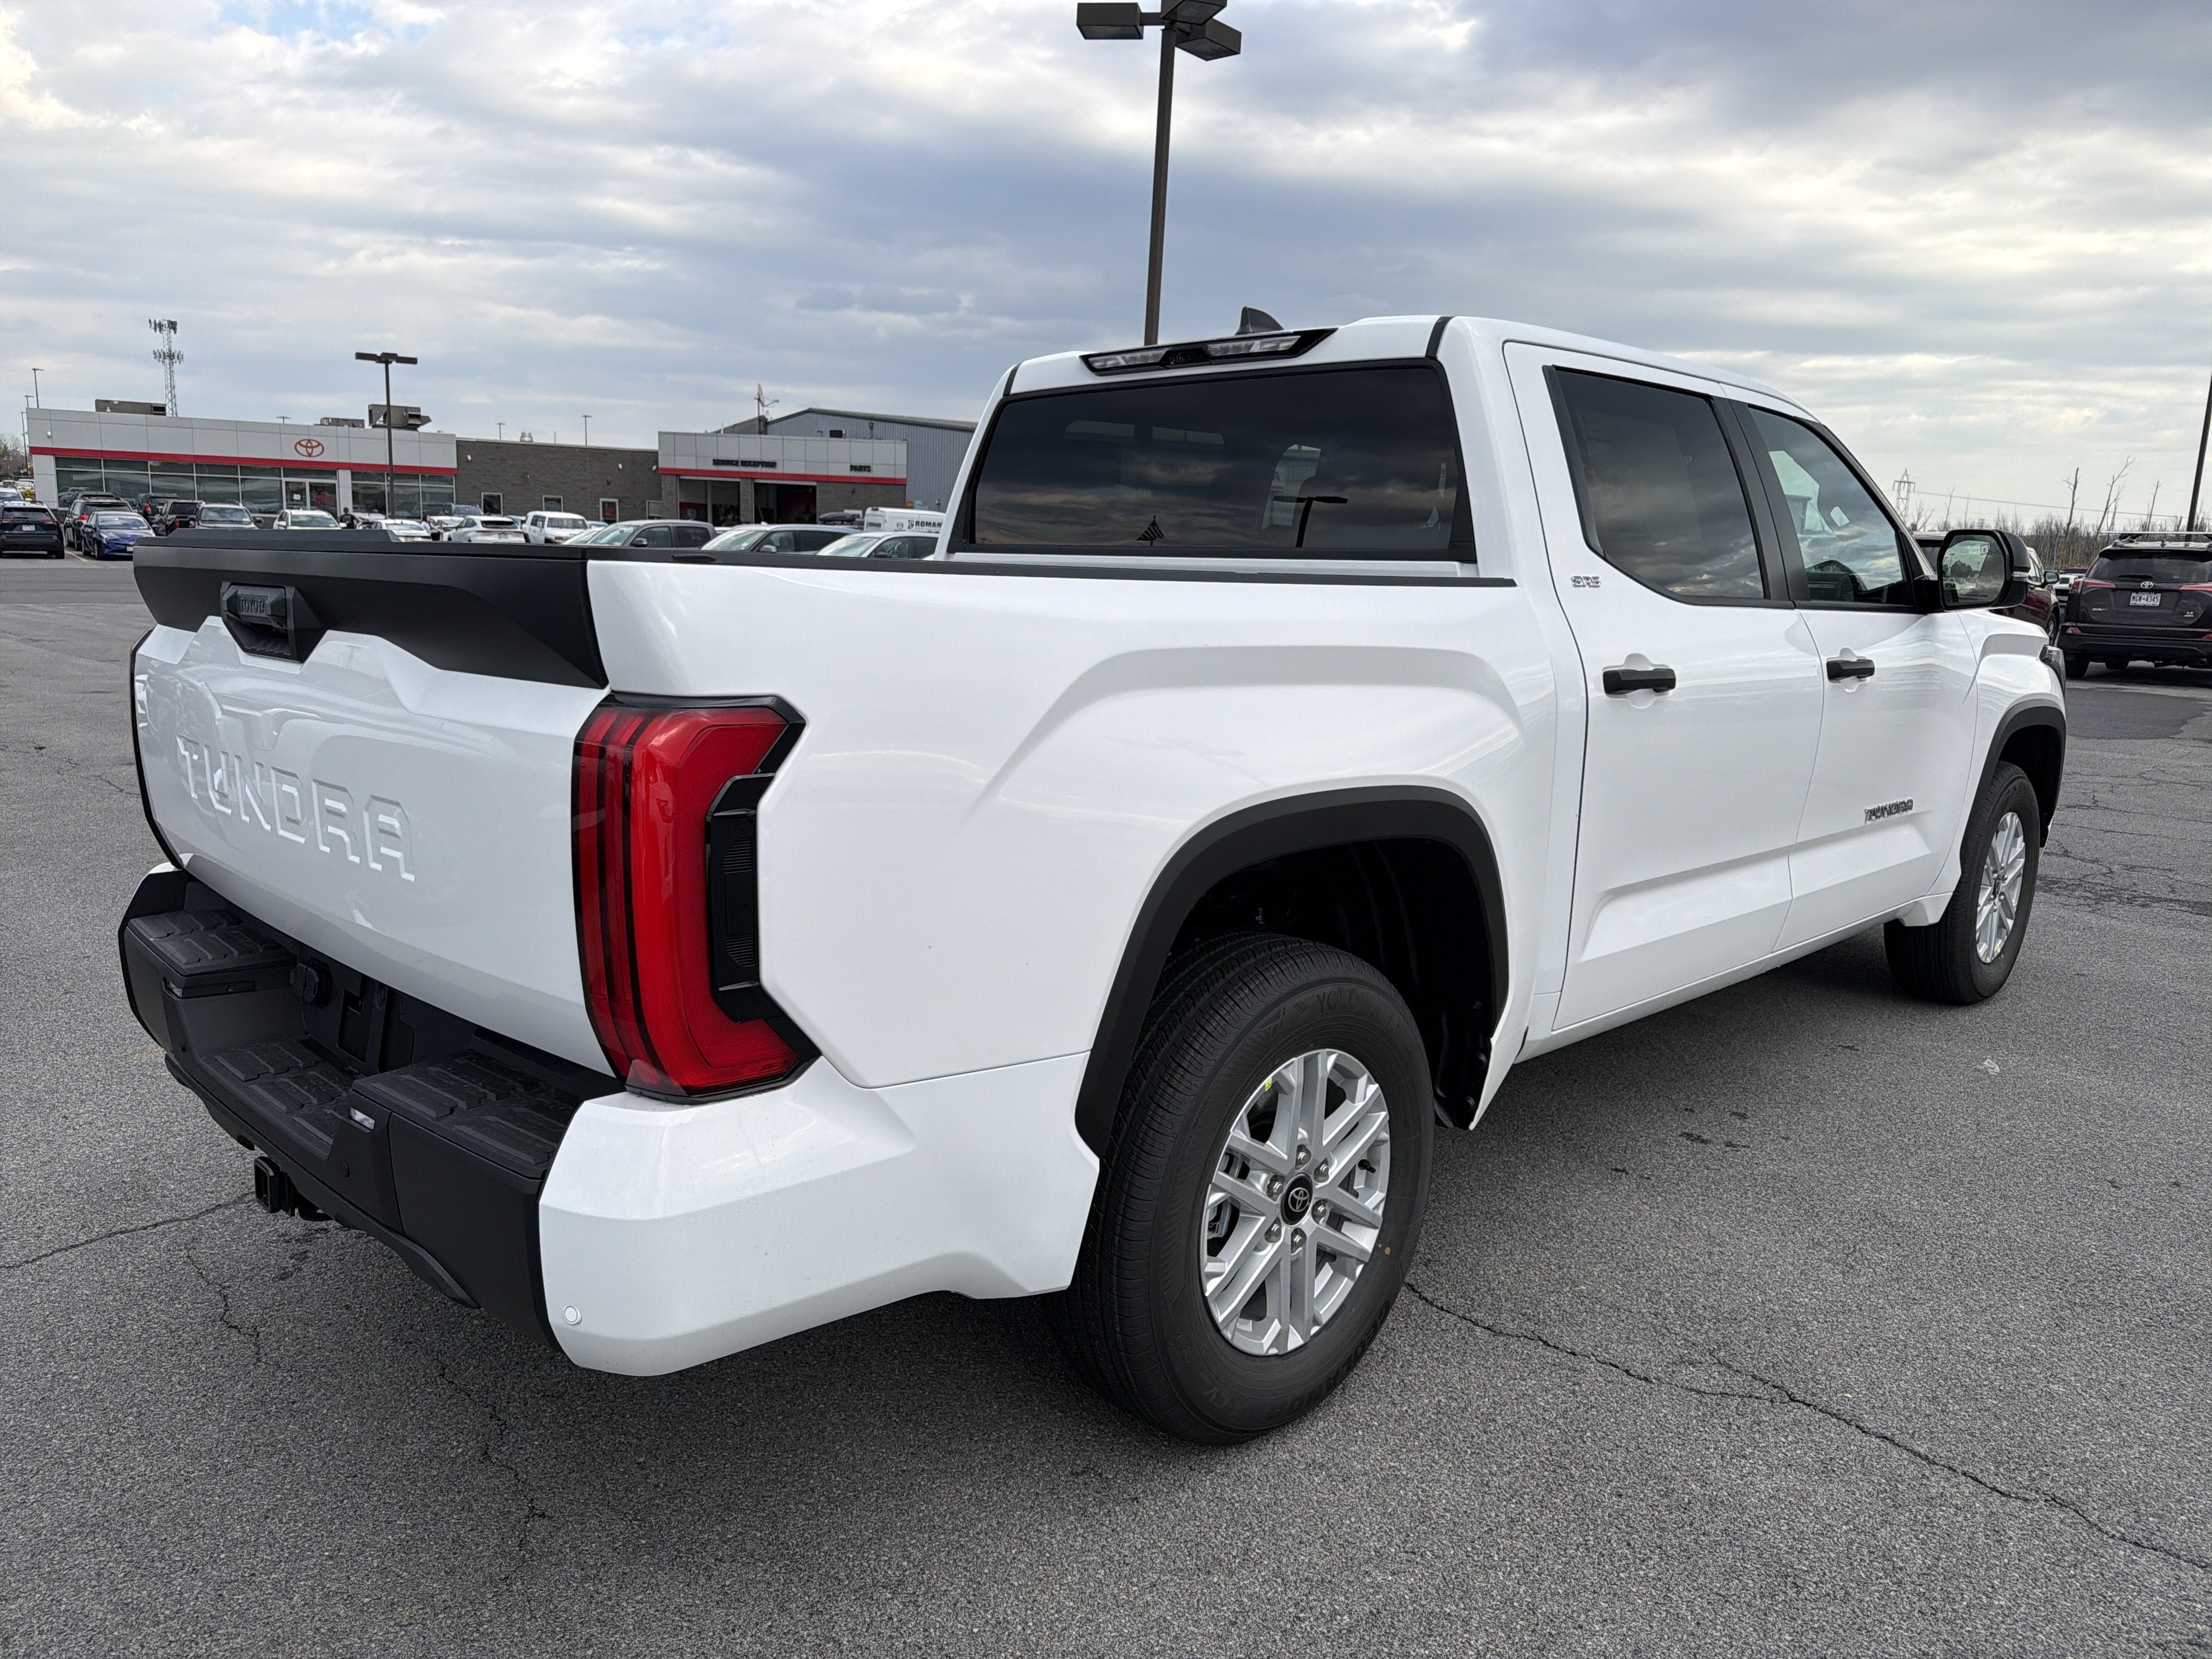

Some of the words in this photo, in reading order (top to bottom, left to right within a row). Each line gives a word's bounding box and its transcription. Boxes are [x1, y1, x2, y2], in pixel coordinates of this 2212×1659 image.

[240, 596, 267, 613] TOYOTA
[177, 733, 415, 882] TUNDRA
[1864, 798, 1914, 823] TUNDRA
